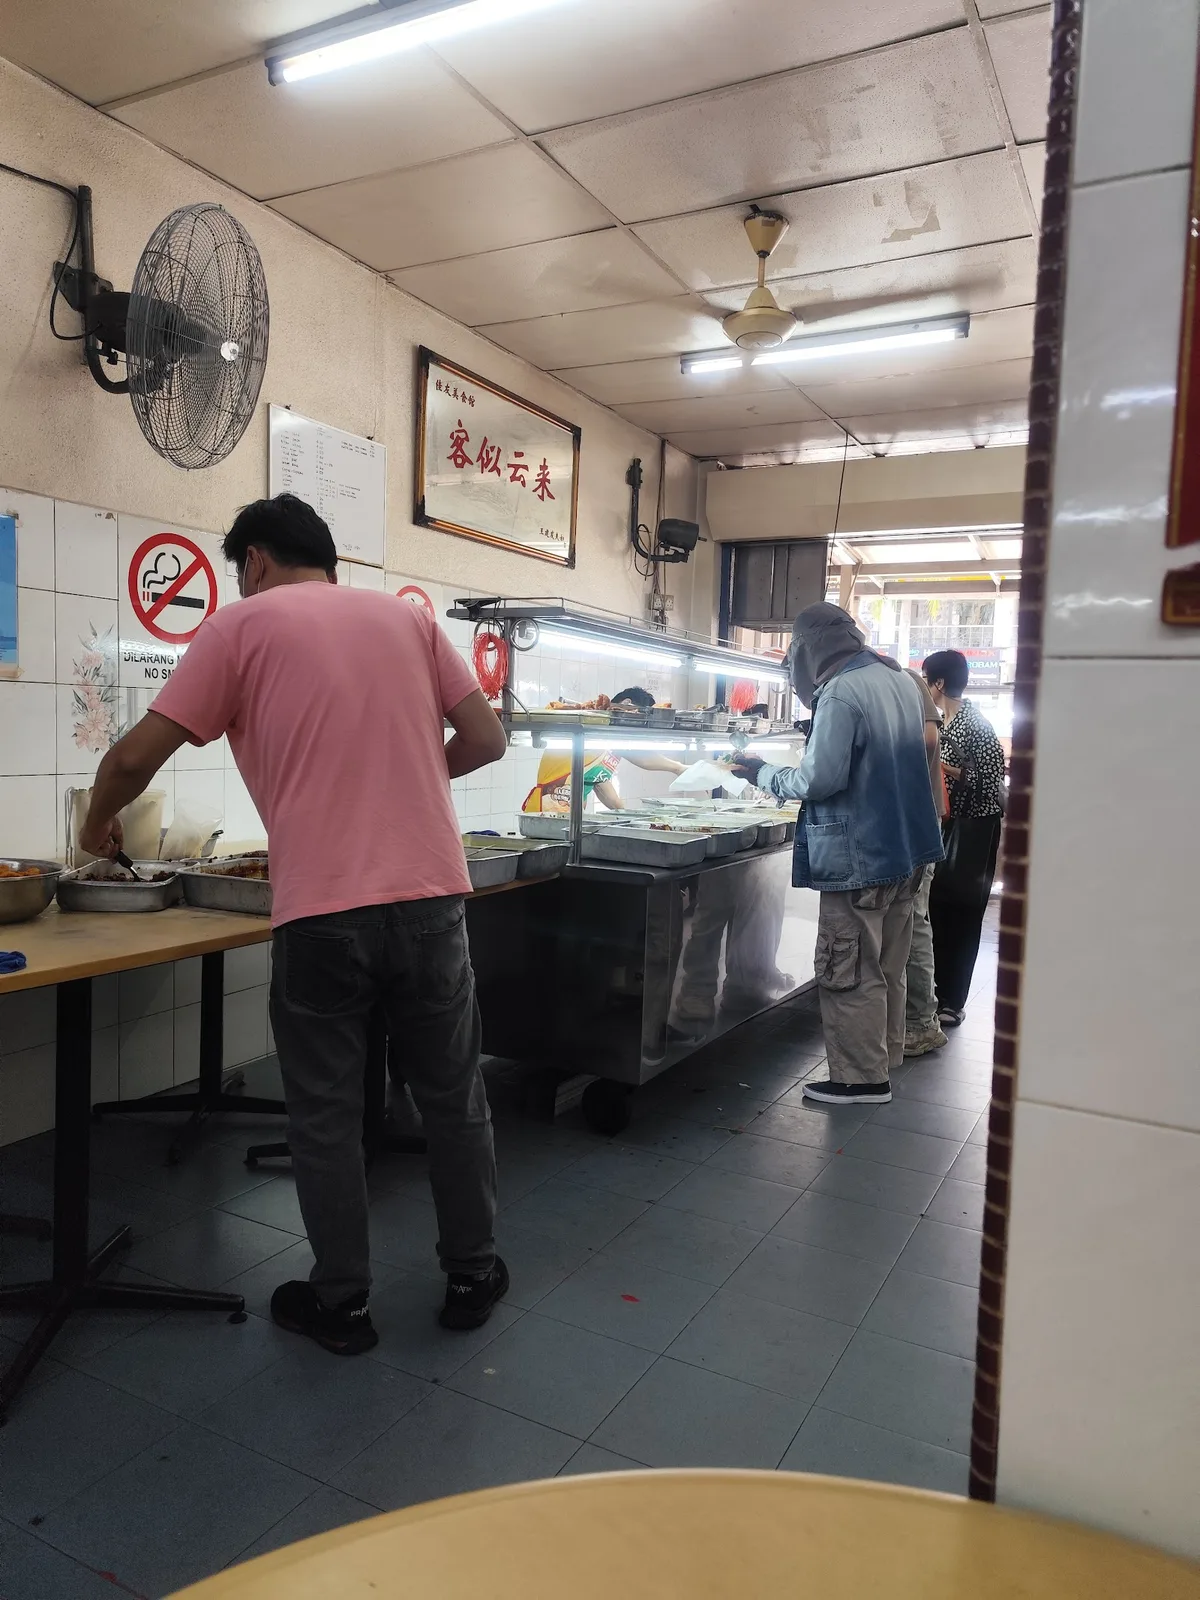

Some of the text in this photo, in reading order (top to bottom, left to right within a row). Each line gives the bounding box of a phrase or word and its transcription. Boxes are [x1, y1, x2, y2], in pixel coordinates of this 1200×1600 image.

[446, 419, 555, 502] 客似云来
[123, 652, 174, 665] DILARANG
[967, 661, 998, 669] ROBAM
[144, 667, 158, 679] NO
